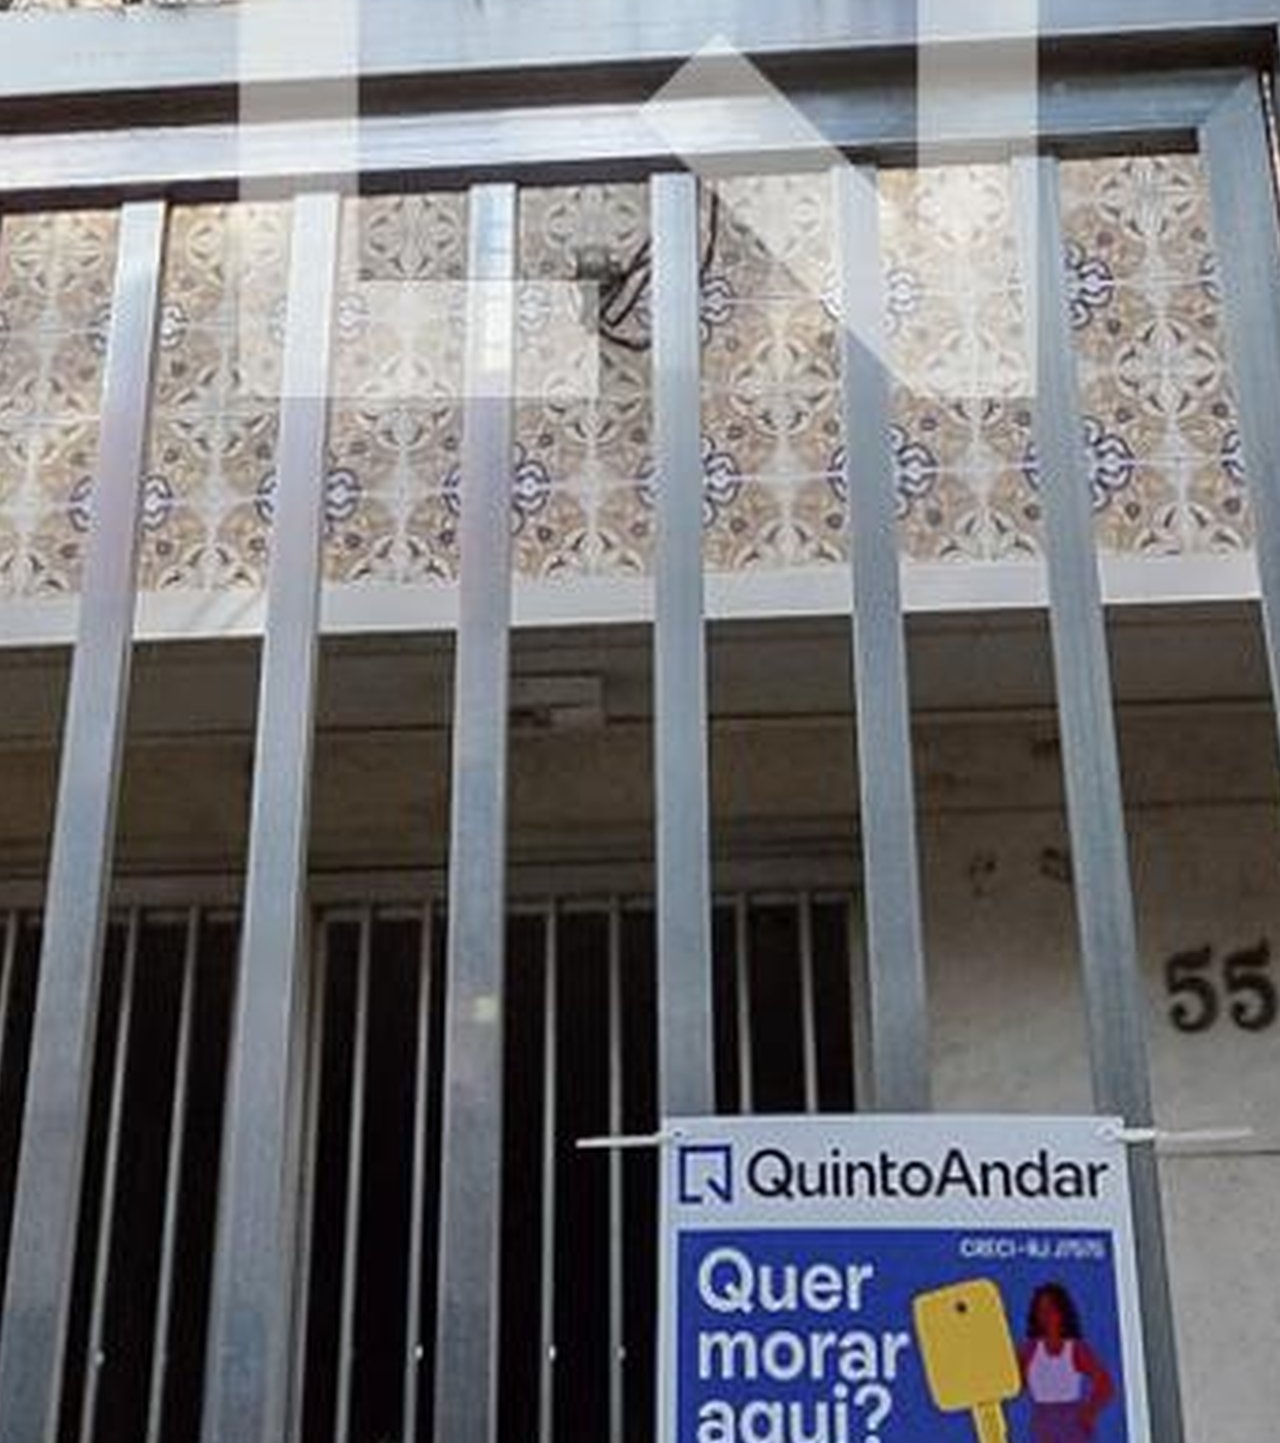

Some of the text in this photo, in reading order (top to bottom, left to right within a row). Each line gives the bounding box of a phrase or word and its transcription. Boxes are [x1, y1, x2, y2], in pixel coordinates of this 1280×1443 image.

[1165, 938, 1278, 1033] 55
[745, 1147, 1110, 1202] QuintoAndar
[696, 1247, 874, 1315] Quer
[696, 1329, 910, 1381] morar
